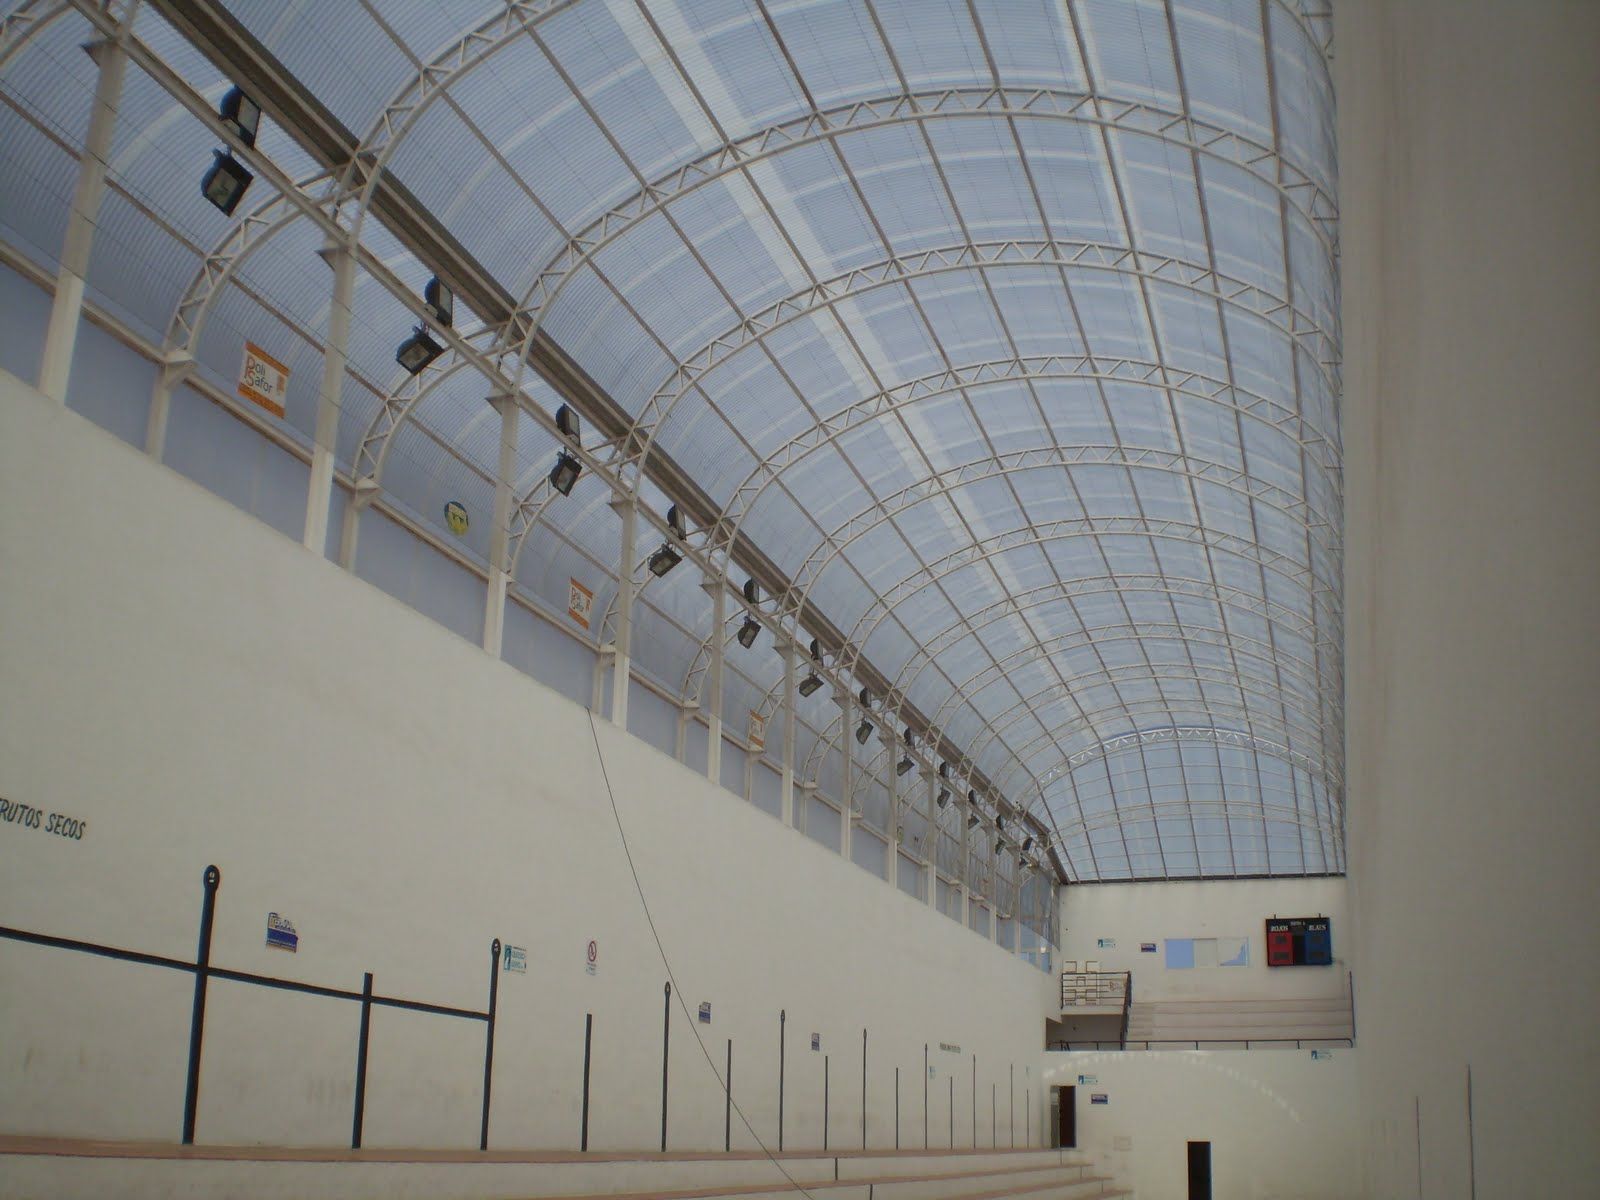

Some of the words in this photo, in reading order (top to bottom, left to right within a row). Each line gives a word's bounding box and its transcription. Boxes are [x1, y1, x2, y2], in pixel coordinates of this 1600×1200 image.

[245, 355, 266, 379] Poli
[246, 368, 273, 394] Safor
[0, 797, 42, 829] RUTOS
[45, 813, 86, 840] SECOS
